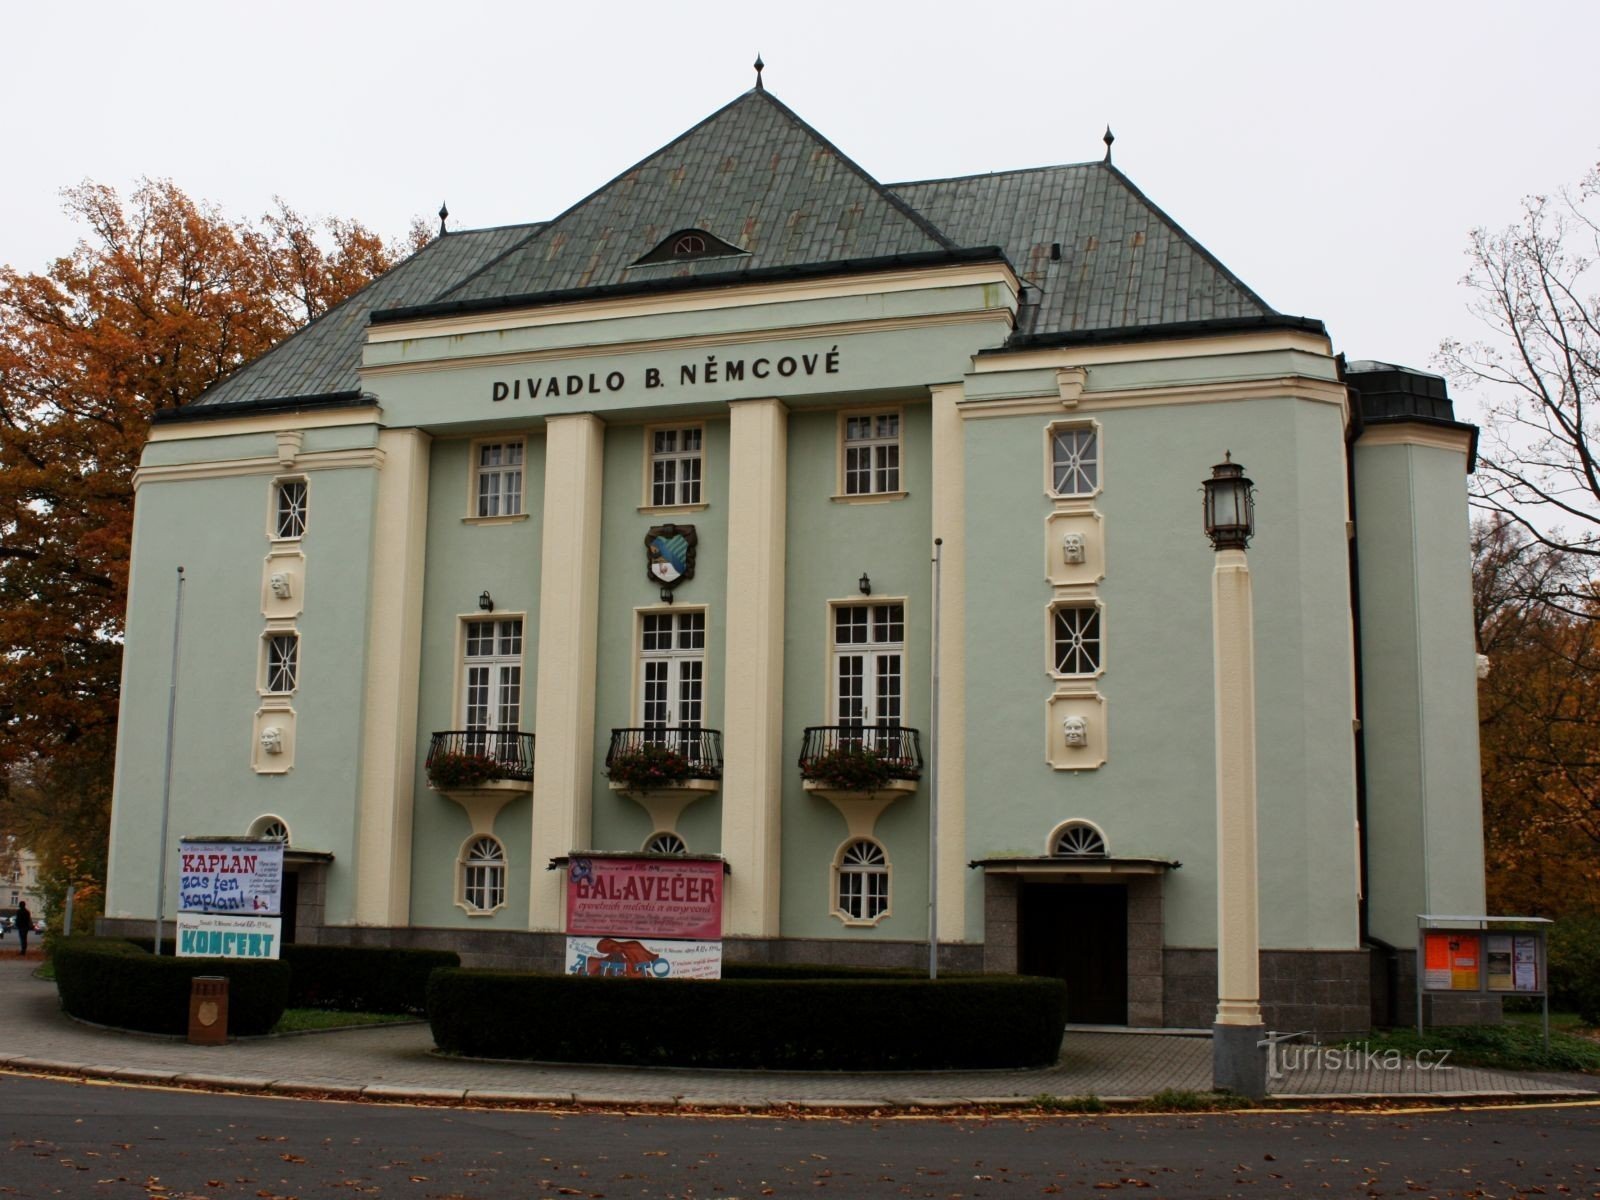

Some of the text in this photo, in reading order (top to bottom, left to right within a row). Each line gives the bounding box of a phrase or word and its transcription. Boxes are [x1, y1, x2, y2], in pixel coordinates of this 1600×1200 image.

[492, 345, 840, 402] DIVADLO B. NĚMCOVÉ
[182, 854, 258, 873] KAPLAN
[182, 875, 209, 890] zas
[214, 873, 239, 891] ten
[576, 873, 715, 903] GALAVEČER
[180, 891, 245, 910] kaplan!
[181, 931, 274, 957] KONCERT
